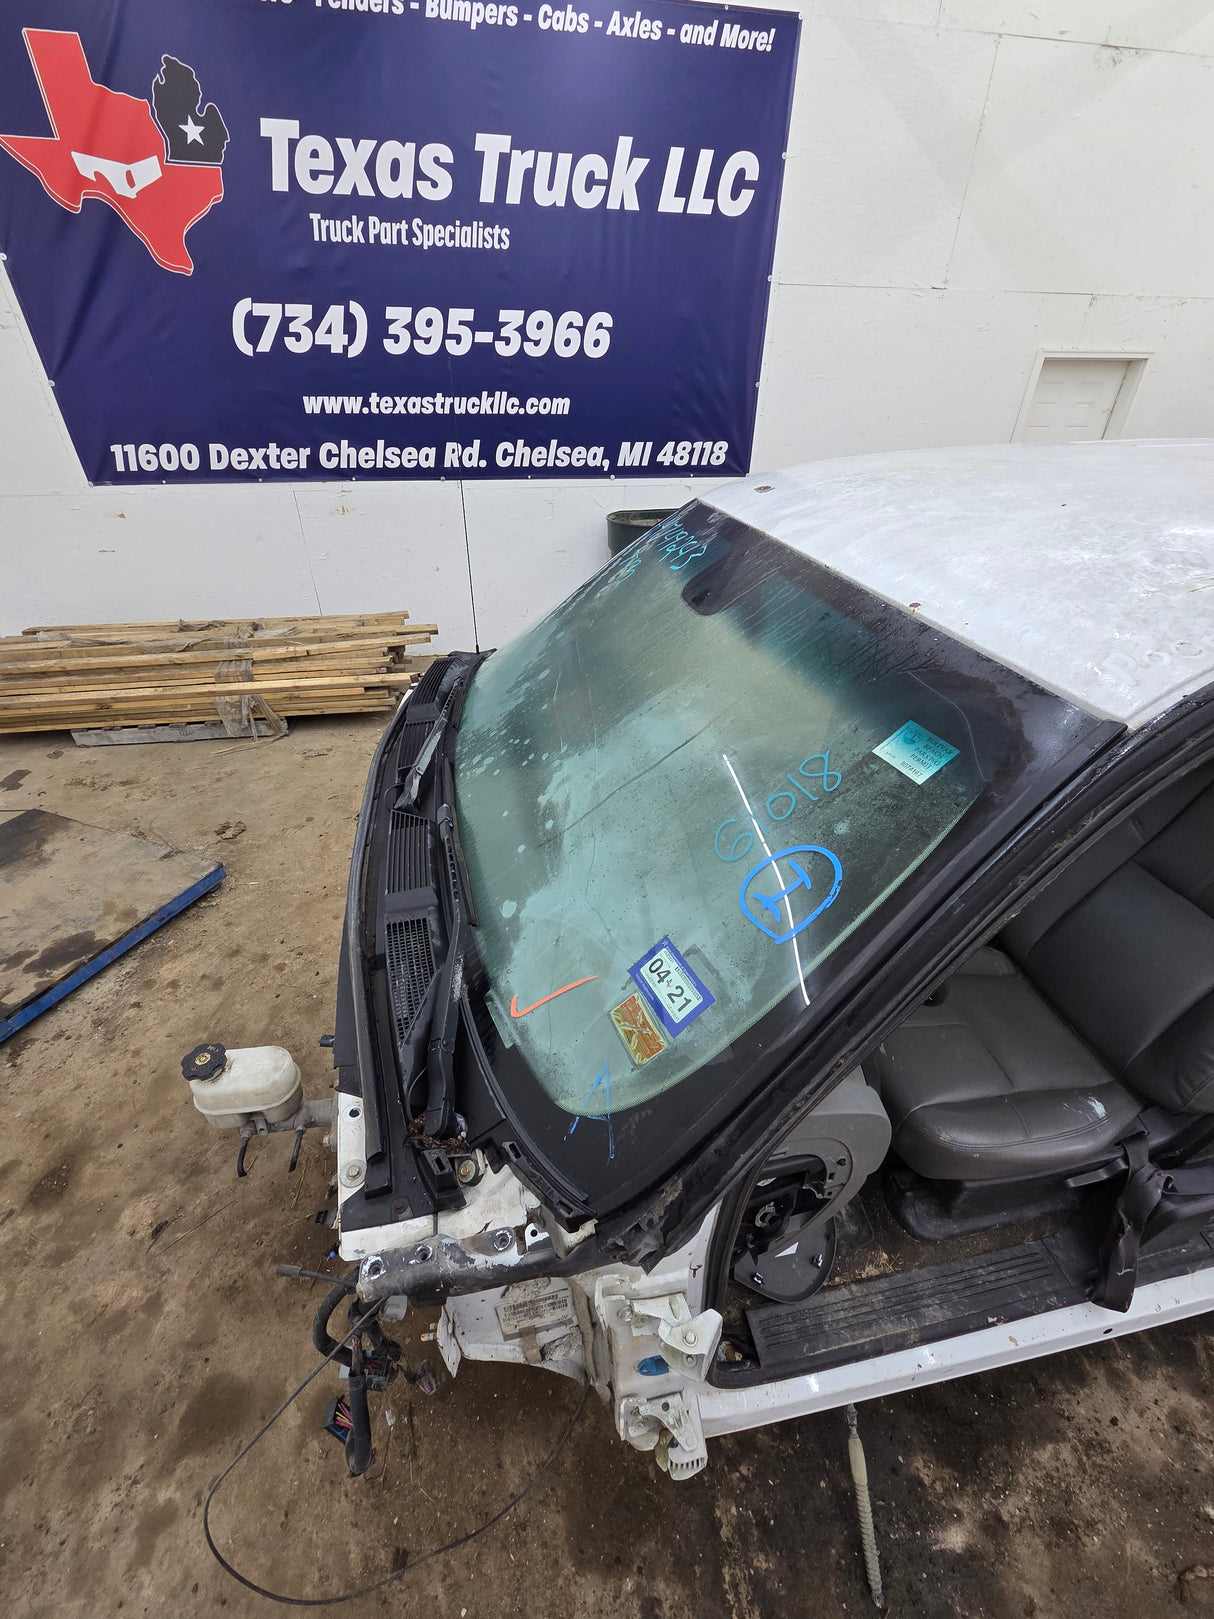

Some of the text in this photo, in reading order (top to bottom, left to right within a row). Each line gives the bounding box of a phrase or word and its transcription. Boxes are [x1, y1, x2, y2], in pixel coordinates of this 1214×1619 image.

[425, 0, 519, 31] Bumpers
[537, 4, 590, 33] Cabs
[606, 11, 663, 40] Axles
[680, 20, 719, 46] and
[720, 24, 776, 52] More!
[259, 117, 760, 217] Texas Truck LLC
[309, 212, 511, 250] Truck Part Specialists
[232, 298, 614, 359] (734) 395-3966
[303, 391, 571, 416] www.texastruckllc.com
[110, 439, 729, 473] 11600 Dexter Chelsea Rd. Chelsea, MI 48118
[910, 753, 933, 770] PERMIT
[914, 746, 941, 766] PARKING
[923, 743, 945, 759] BEACH
[648, 957, 673, 984] 04
[667, 984, 692, 1012] 21
